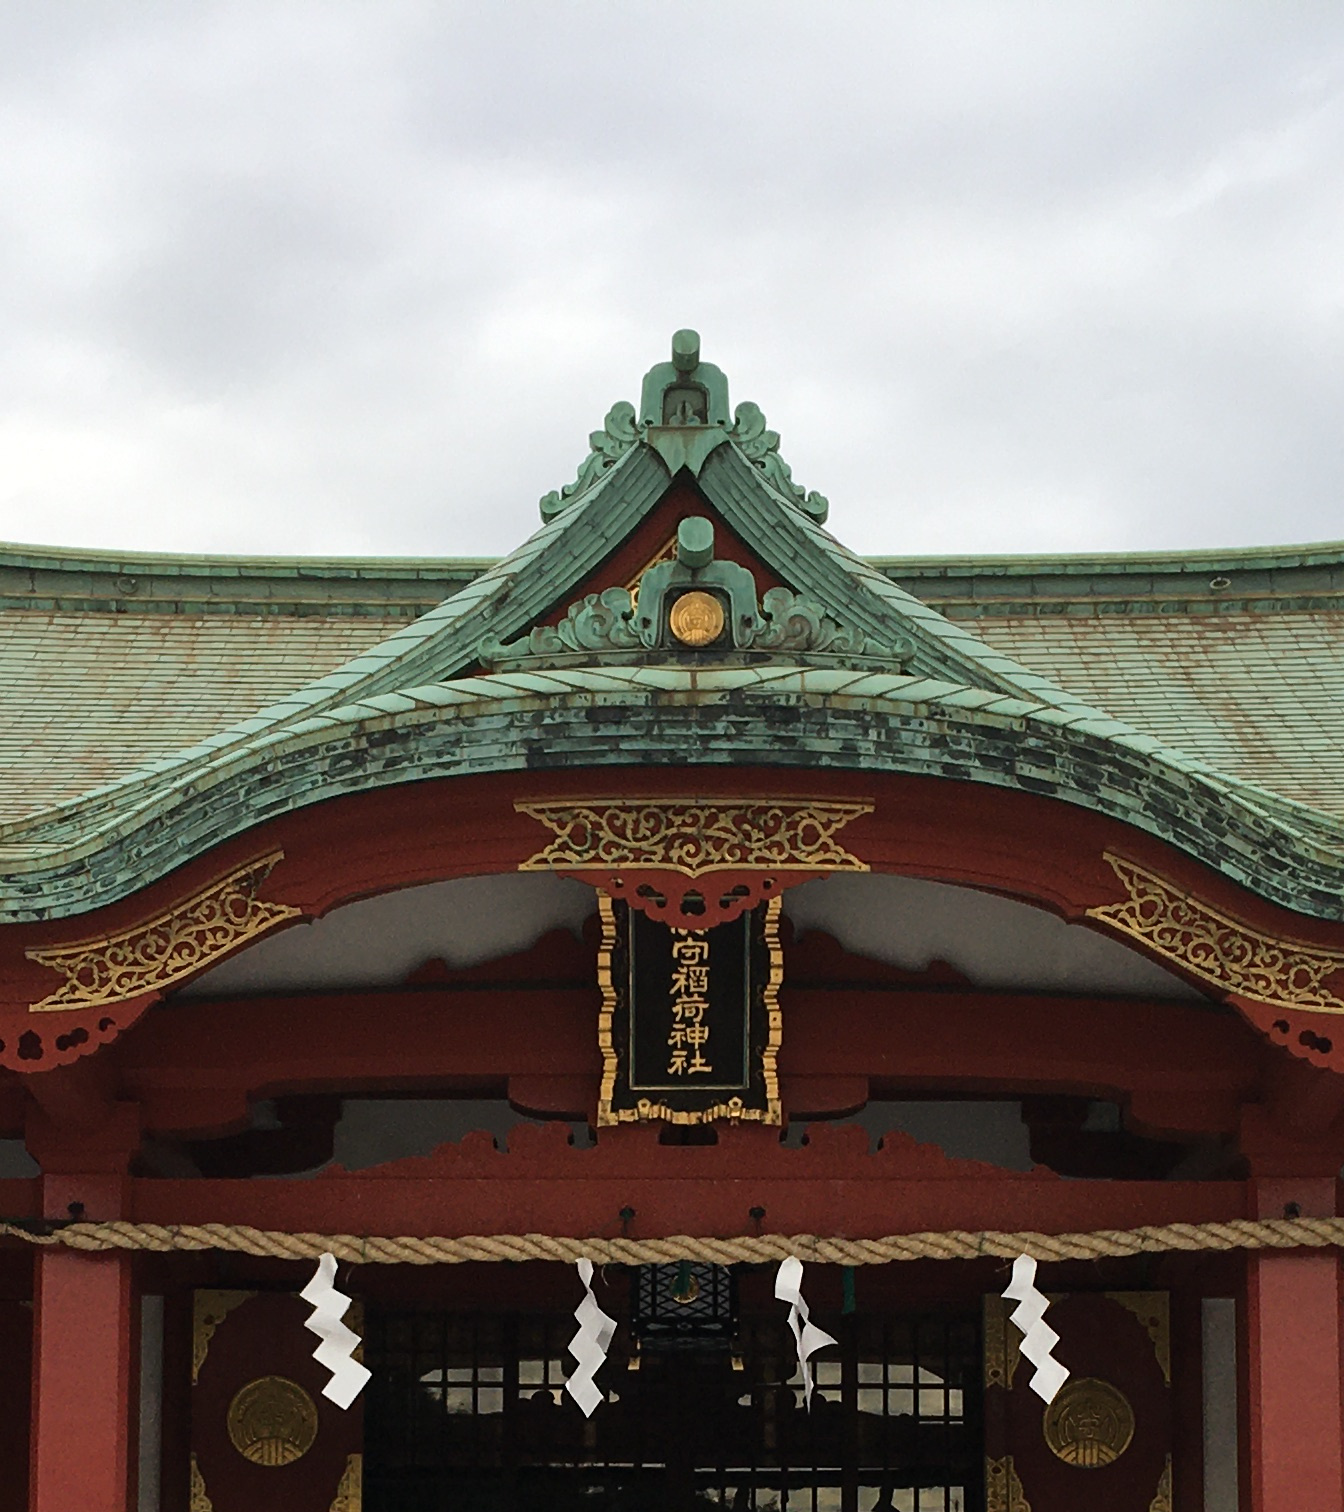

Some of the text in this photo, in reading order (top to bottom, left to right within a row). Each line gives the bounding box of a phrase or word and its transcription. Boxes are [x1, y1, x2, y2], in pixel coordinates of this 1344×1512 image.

[667, 928, 713, 1076] 守稲荷神社
